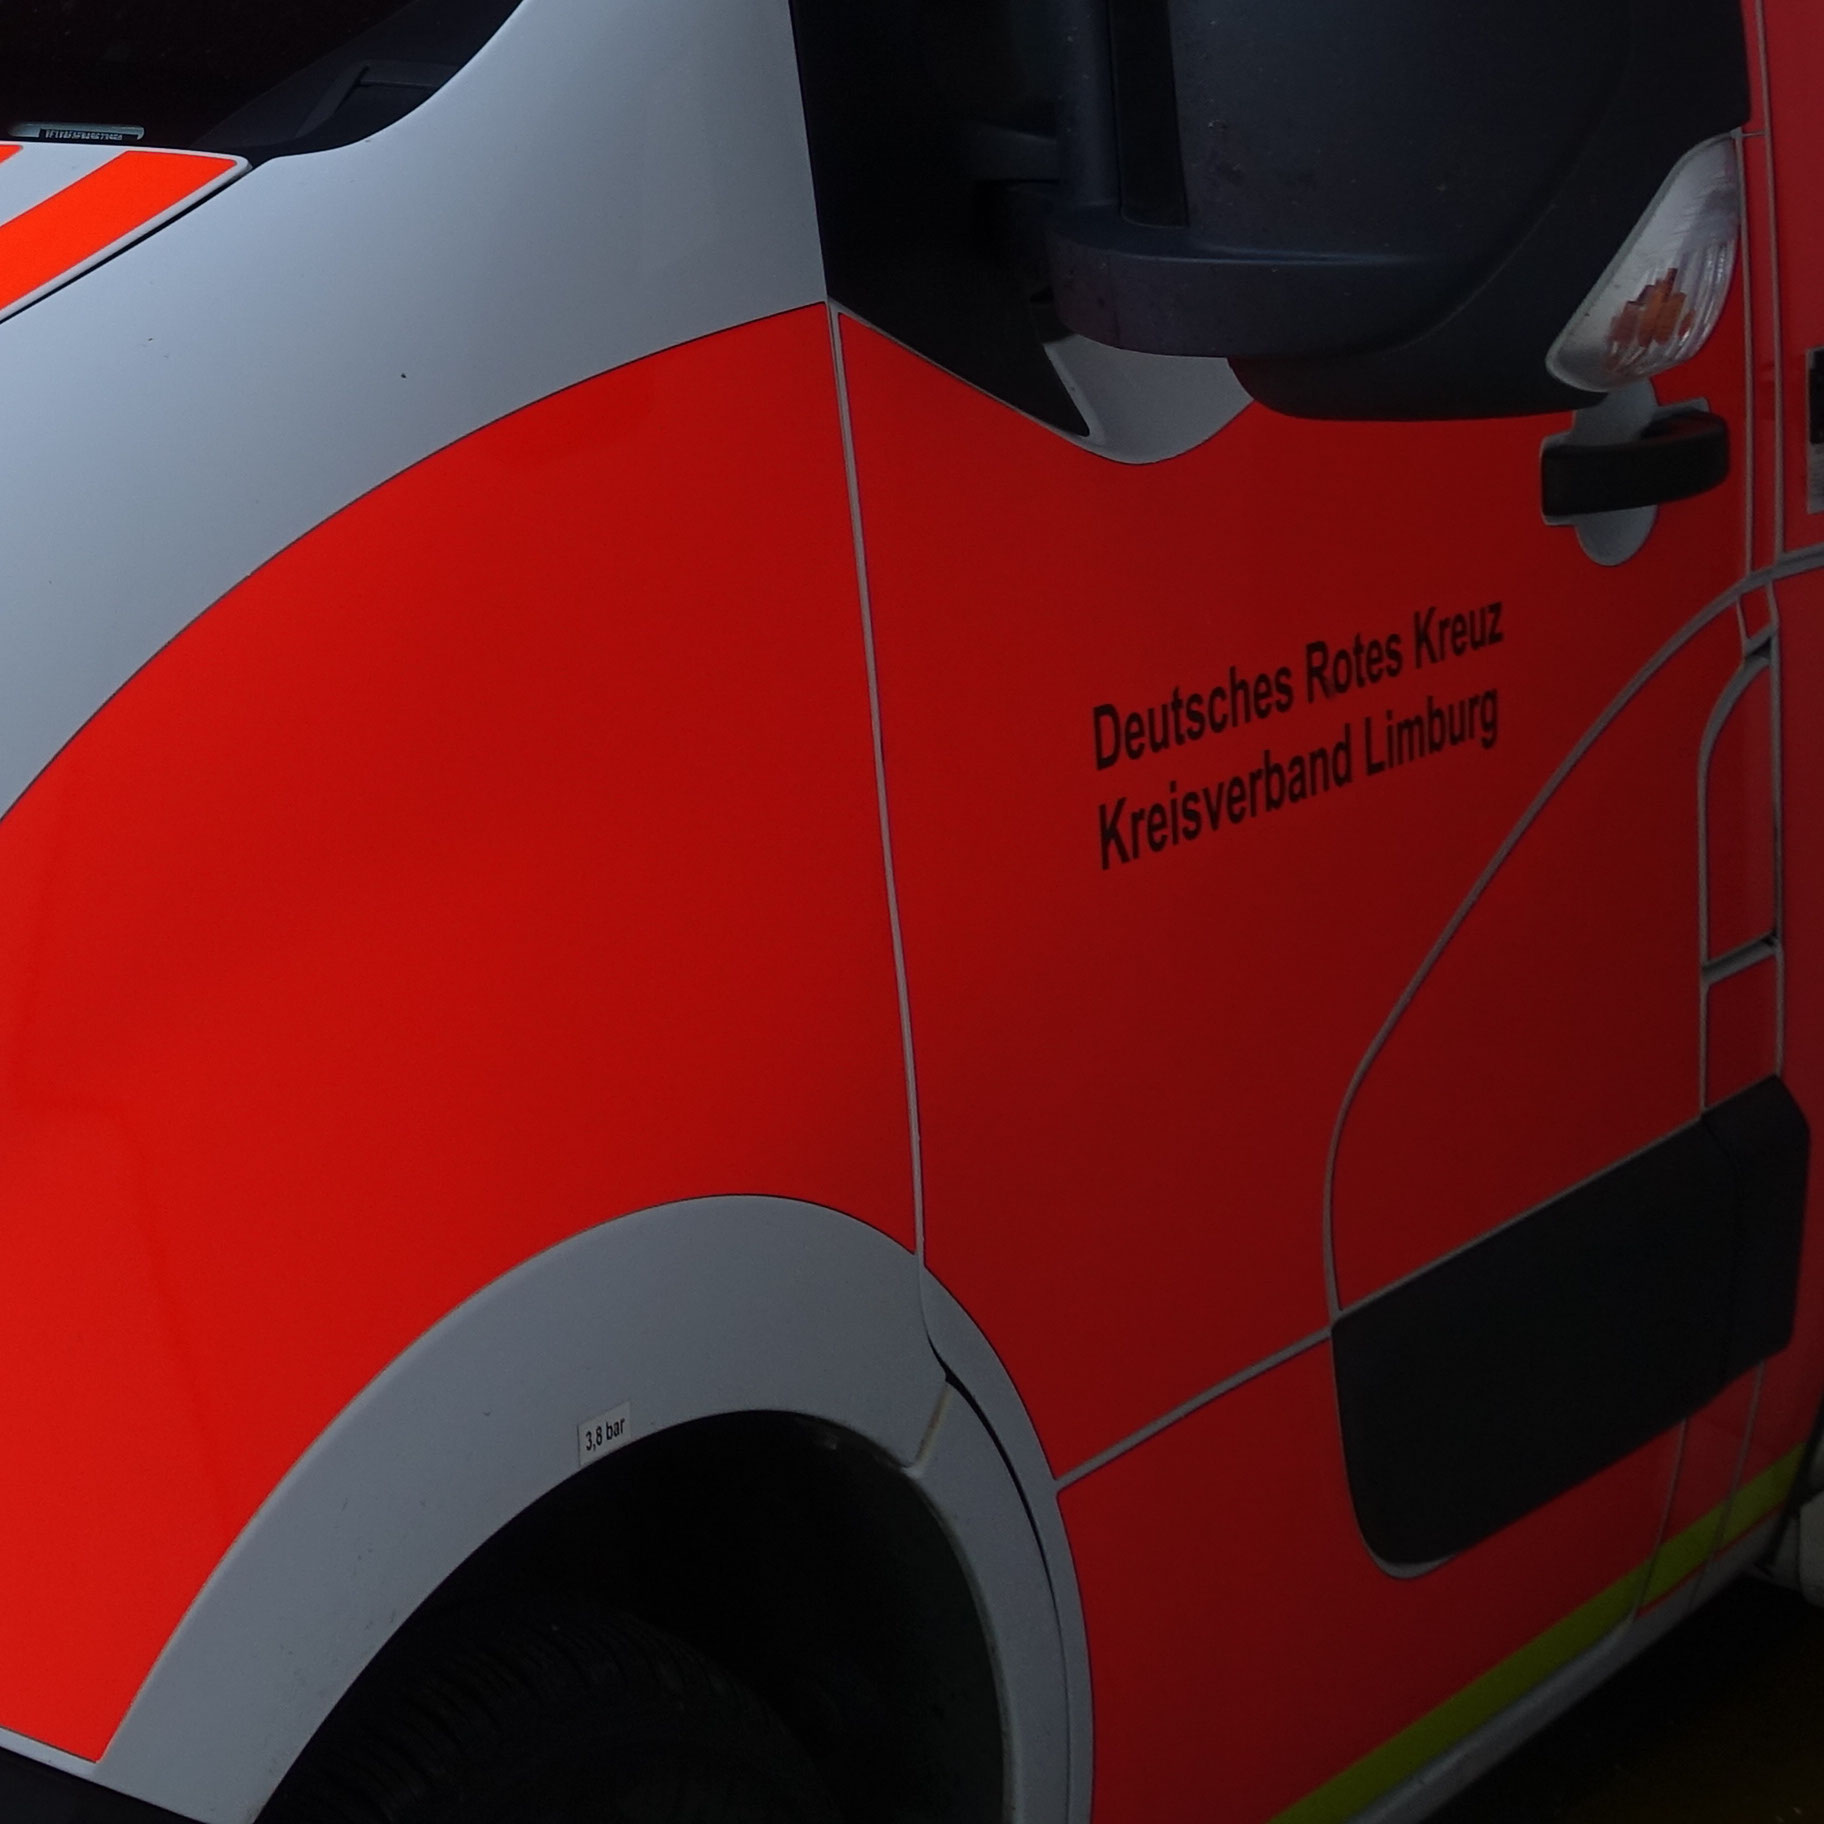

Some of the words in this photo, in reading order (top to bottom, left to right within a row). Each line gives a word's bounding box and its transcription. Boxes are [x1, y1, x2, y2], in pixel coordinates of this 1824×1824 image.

[1093, 666, 1294, 770] Deutsches
[1306, 633, 1402, 704] Rotes
[1414, 602, 1504, 668] Kreuz
[1098, 723, 1352, 870] Kreisverband
[1364, 689, 1499, 775] Limburg
[585, 1426, 603, 1452] 3,8
[606, 1418, 625, 1440] bar
